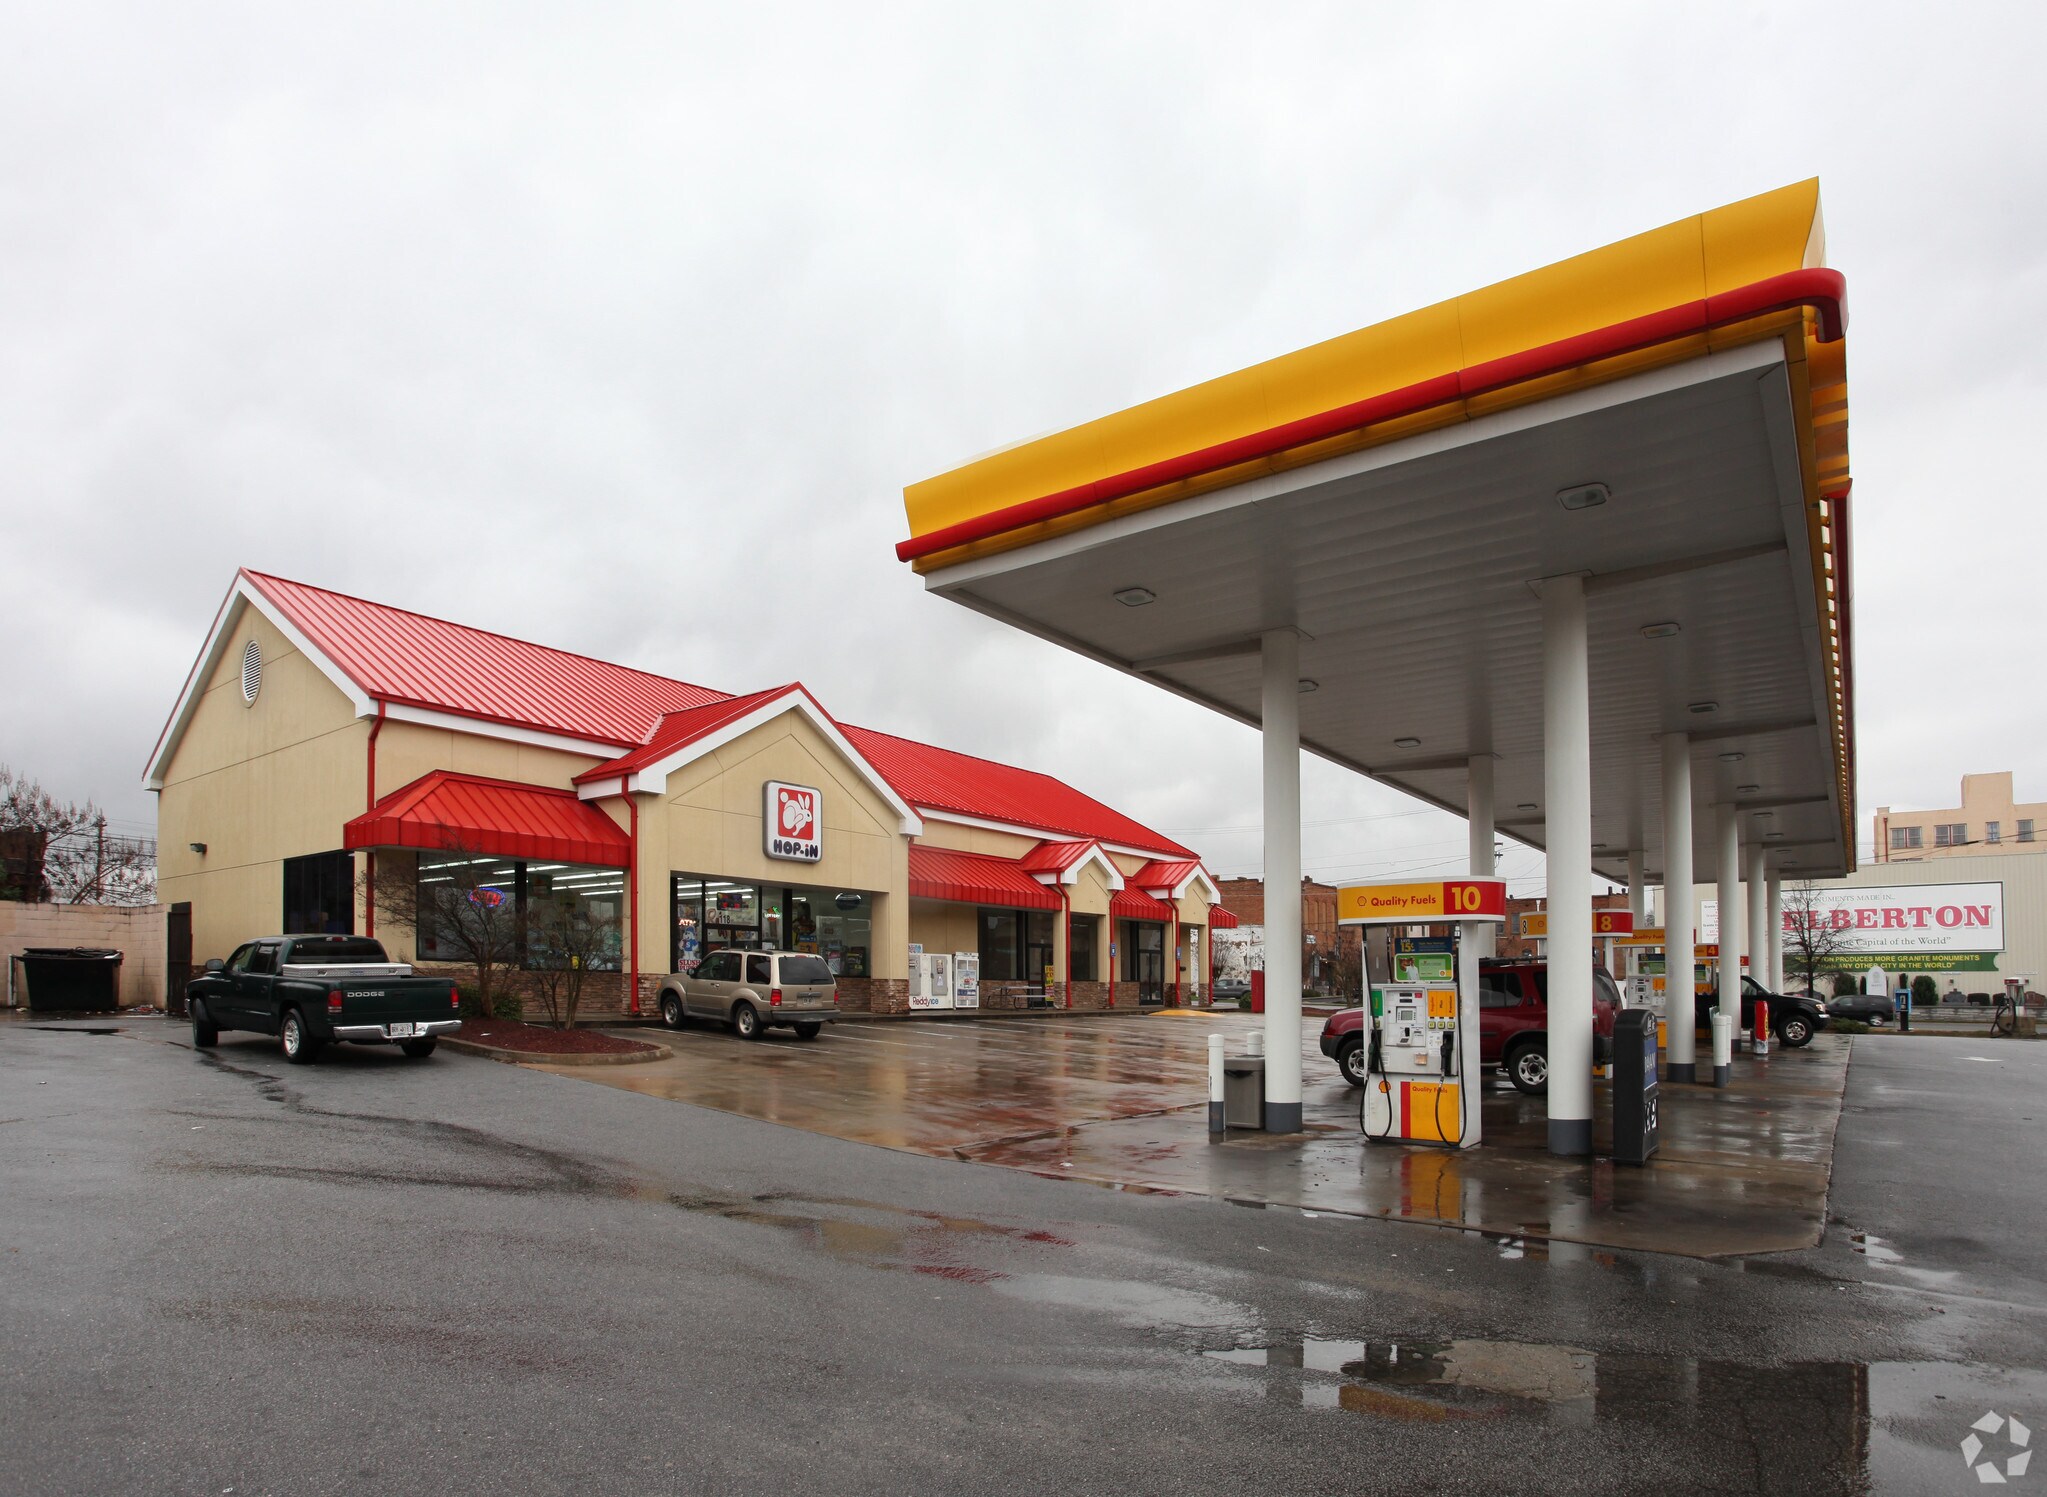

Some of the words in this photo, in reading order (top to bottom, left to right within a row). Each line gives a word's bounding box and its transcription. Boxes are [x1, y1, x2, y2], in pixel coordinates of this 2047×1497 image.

[1371, 896, 1408, 908] Quality
[1411, 894, 1437, 905] Fuels
[1451, 886, 1481, 911] 10
[719, 915, 731, 924] 118
[1601, 915, 1613, 931] 8
[1781, 905, 1992, 931] ELBERTON
[1856, 938, 1887, 948] Capital
[1889, 937, 1900, 946] of
[1901, 937, 1916, 945] the
[1708, 946, 1716, 955] 4
[1932, 954, 1980, 962] MONUMENTS
[1412, 1086, 1433, 1094] Quality
